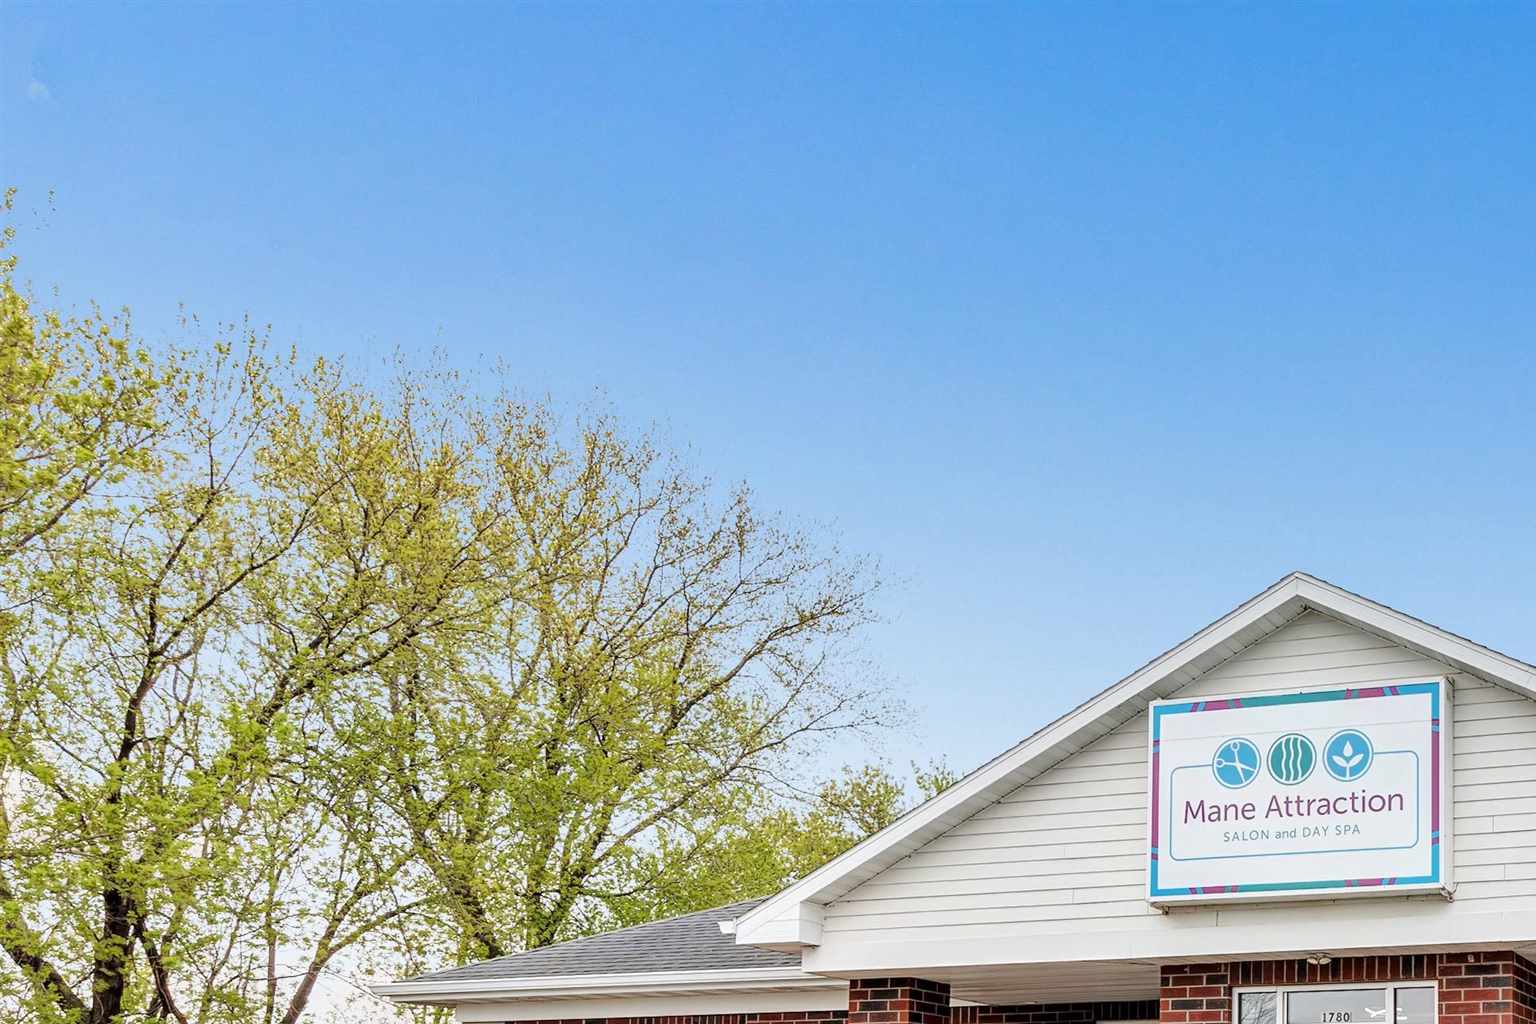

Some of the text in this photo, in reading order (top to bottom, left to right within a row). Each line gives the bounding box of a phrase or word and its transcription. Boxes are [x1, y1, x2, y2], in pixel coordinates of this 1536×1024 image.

[1184, 789, 1404, 825] Mane Attraction
[1223, 823, 1361, 843] SALON and DAY SPA
[1322, 1012, 1350, 1023] 1780
